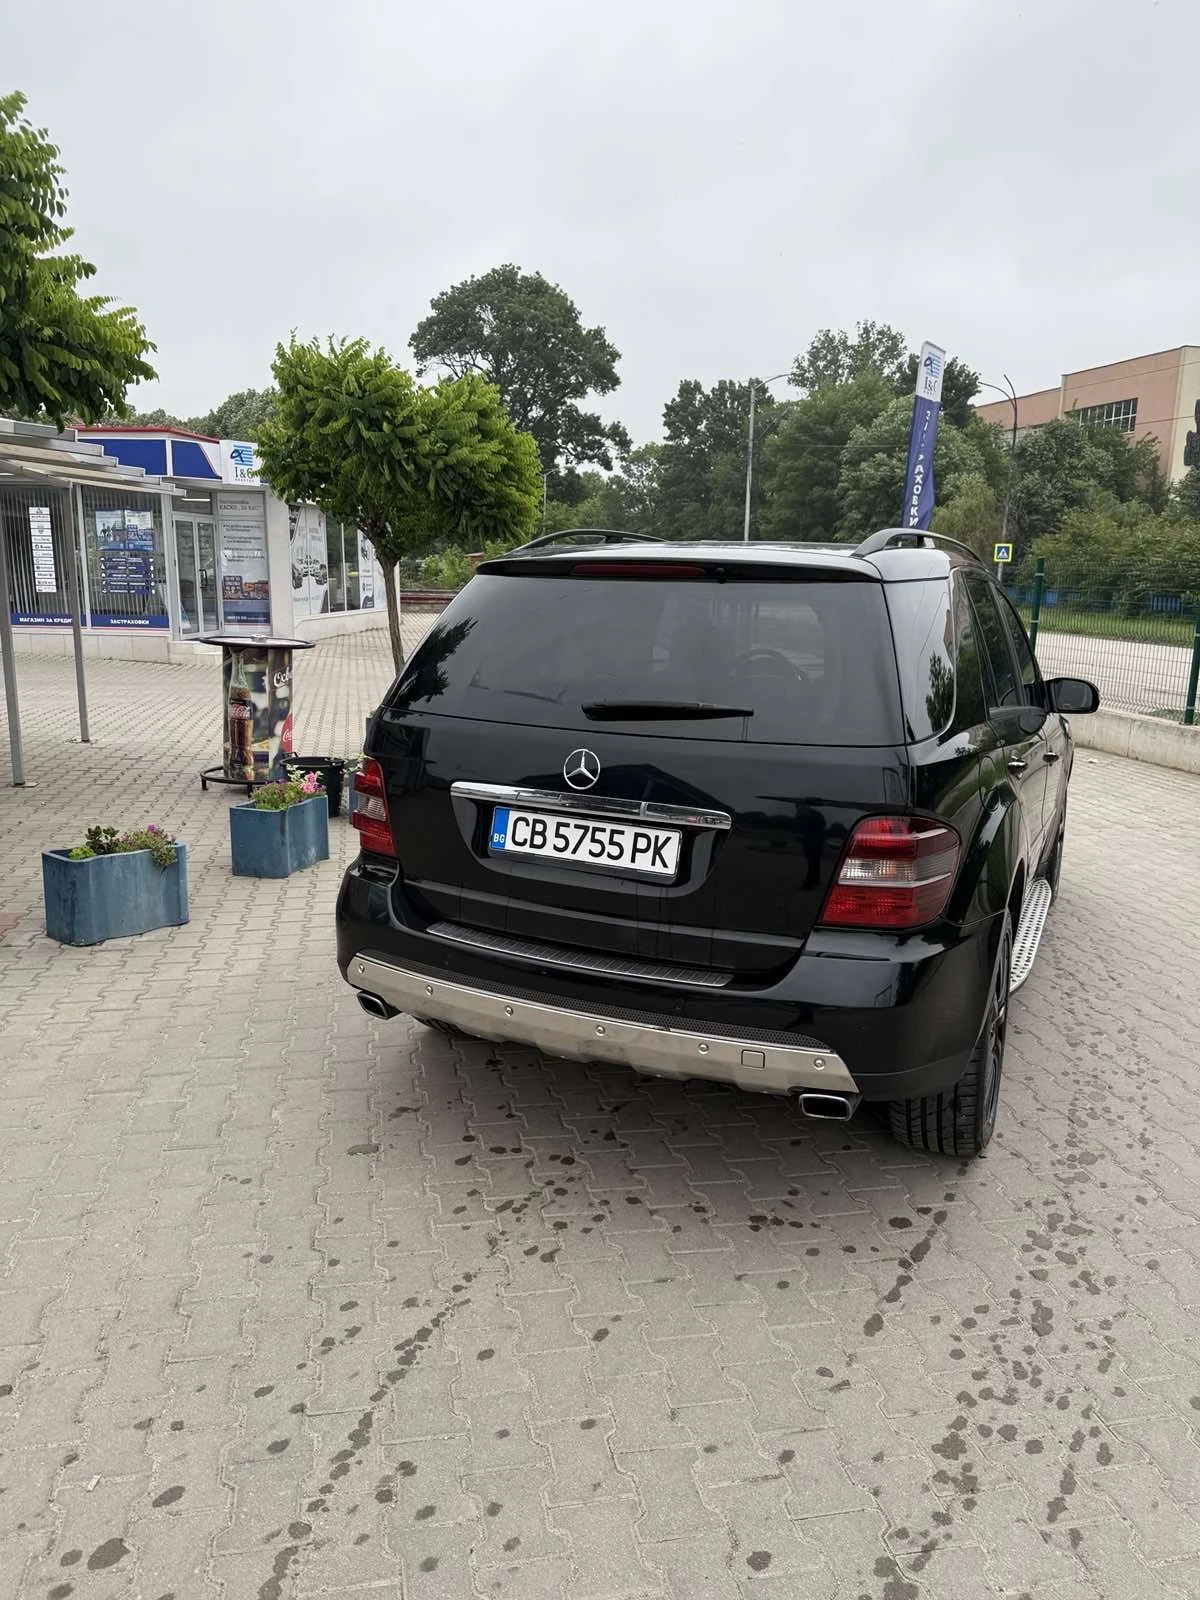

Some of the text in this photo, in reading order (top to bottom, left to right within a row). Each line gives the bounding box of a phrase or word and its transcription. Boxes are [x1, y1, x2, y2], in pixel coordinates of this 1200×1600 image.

[493, 832, 506, 844] BG
[552, 821, 625, 861] 5755
[630, 831, 673, 869] PK
